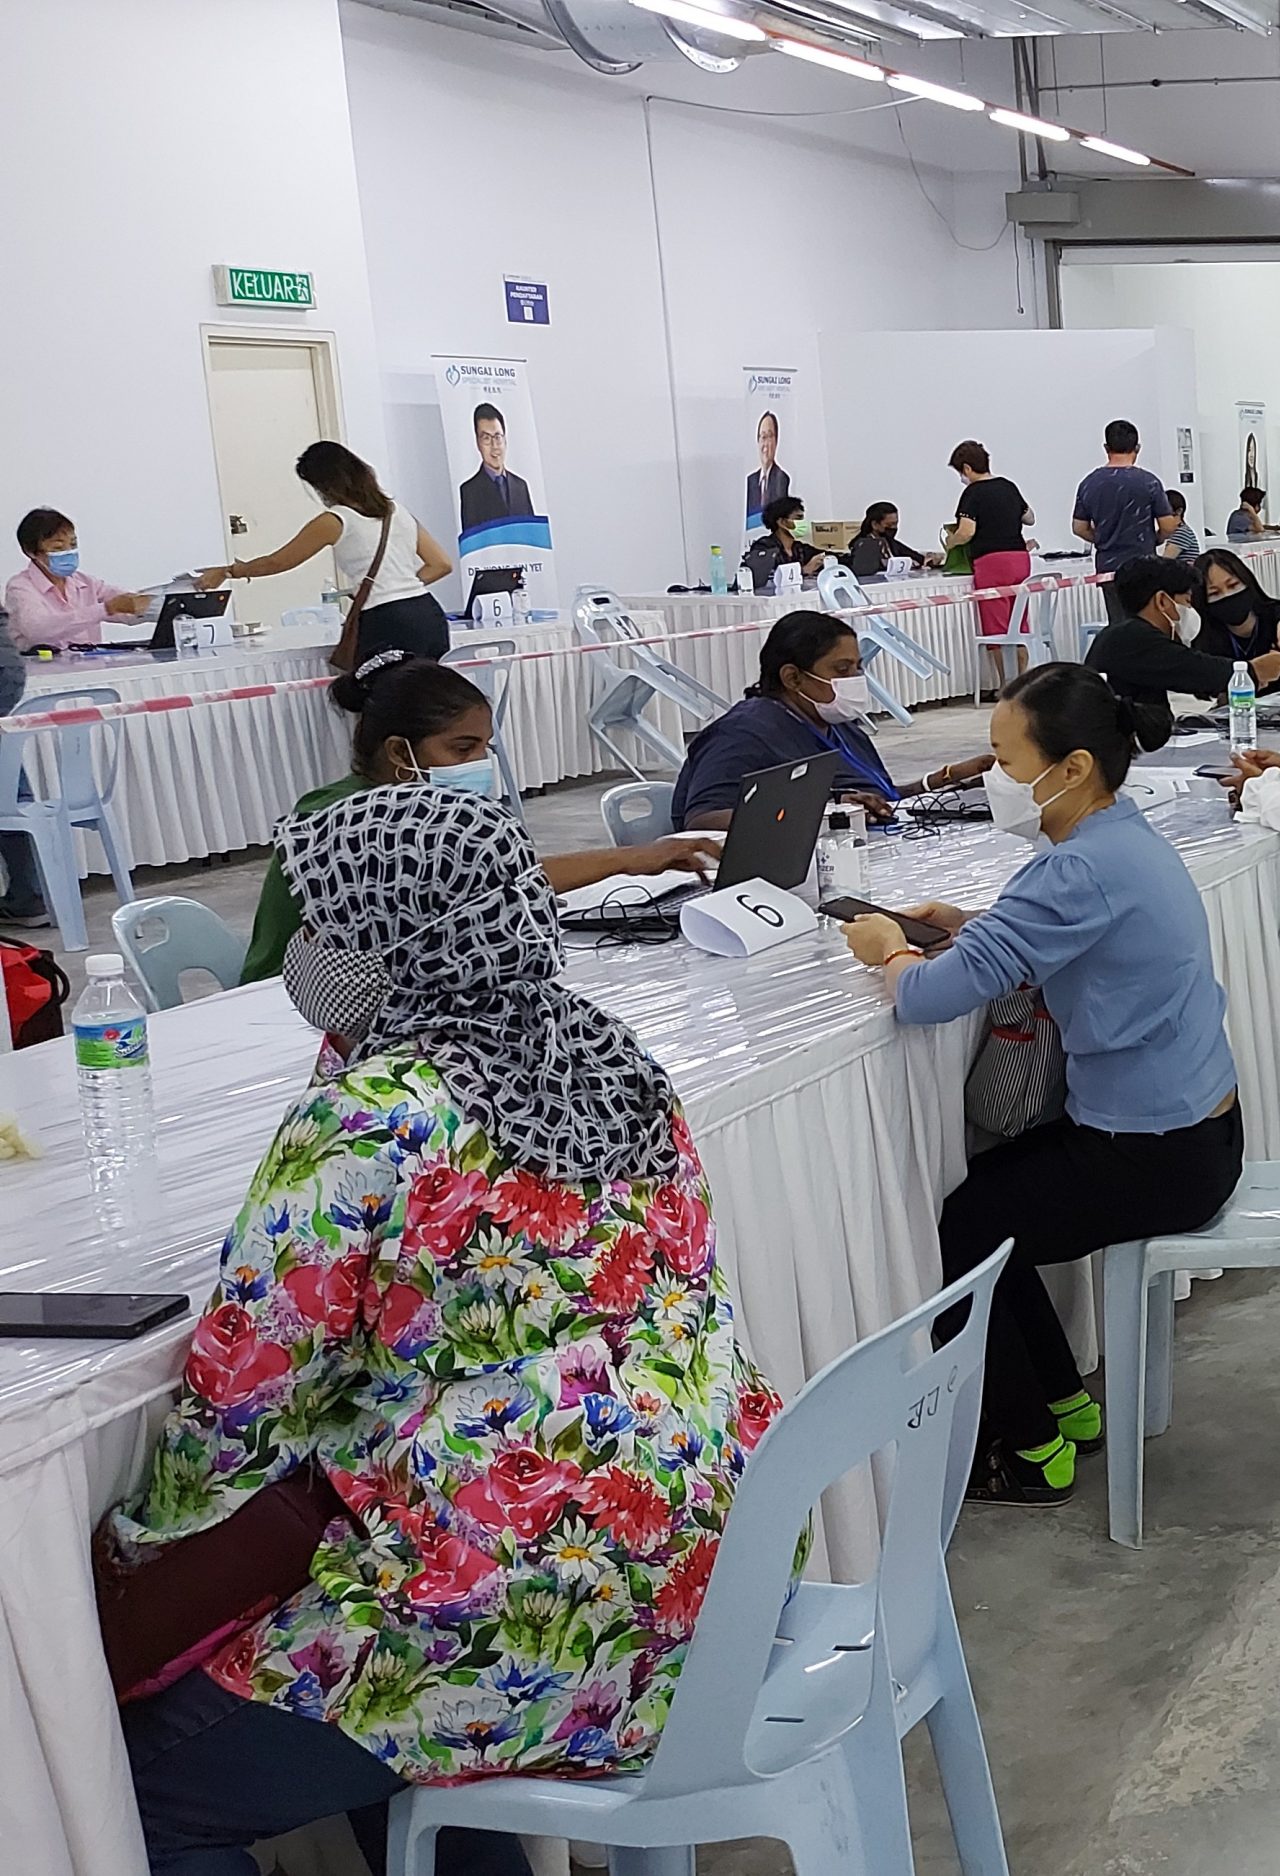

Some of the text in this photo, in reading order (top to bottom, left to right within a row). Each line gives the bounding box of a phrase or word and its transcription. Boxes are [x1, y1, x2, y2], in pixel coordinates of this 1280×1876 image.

[232, 271, 294, 301] KELUAR
[460, 365, 516, 378] SUNGAI LONG
[529, 563, 543, 572] YET
[788, 567, 794, 582] 4
[897, 560, 905, 574] 3
[493, 599, 502, 617] 6
[203, 624, 215, 645] 7
[736, 894, 784, 928] 6
